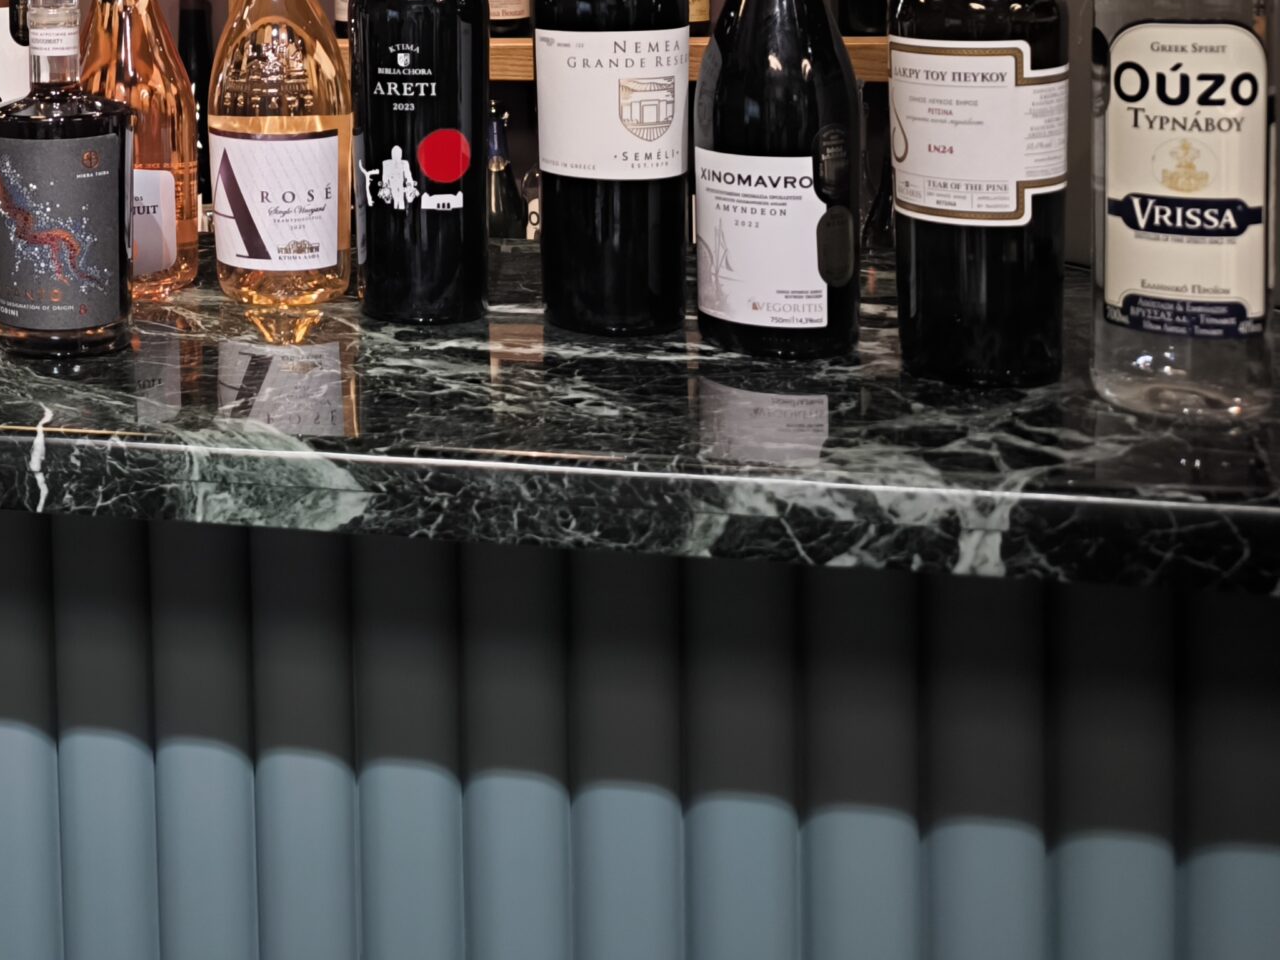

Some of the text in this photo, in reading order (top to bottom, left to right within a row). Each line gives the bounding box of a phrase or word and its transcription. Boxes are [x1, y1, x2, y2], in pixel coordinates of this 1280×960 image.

[388, 43, 420, 54] KTIMA
[613, 40, 680, 54] NEMEA
[1150, 41, 1227, 54] GREEK SPIRIT
[567, 56, 646, 69] GRANDE
[377, 67, 432, 76] BIBLIA CHORA
[924, 70, 948, 82] ΤΟΥ
[951, 71, 1008, 83] ΠΕΥΚΟΥ
[372, 81, 437, 97] ARETI
[392, 103, 415, 111] 2023
[700, 167, 814, 189] XINOMAVRO
[927, 180, 1009, 192] TEAR OF THE PINE
[260, 183, 332, 204] ROSÉ
[715, 203, 787, 217] AMYNDEON
[1131, 197, 1239, 230] VRISSA
[757, 302, 823, 314] VEGORITIS
